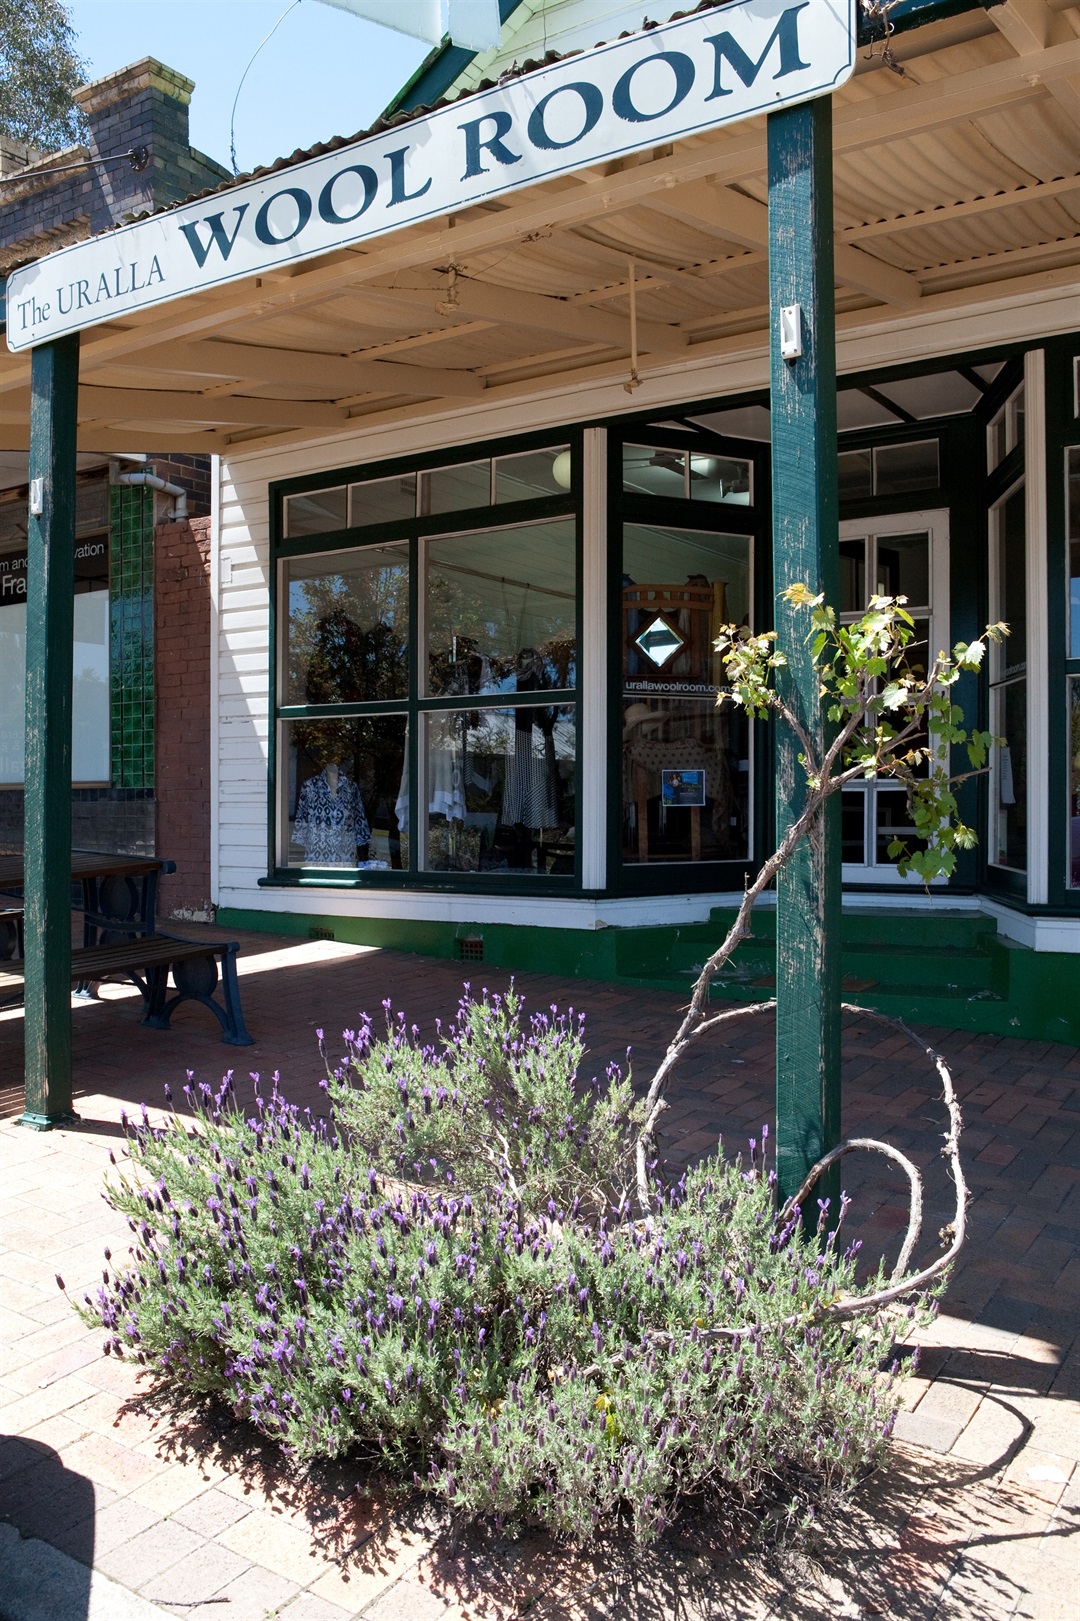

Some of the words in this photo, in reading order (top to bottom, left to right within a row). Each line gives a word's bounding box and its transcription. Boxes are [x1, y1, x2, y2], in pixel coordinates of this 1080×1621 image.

[17, 298, 51, 330] The
[56, 254, 166, 316] URALLA
[178, 145, 432, 269] WOOL
[457, 2, 811, 182] ROOM
[2, 574, 28, 596] Fra
